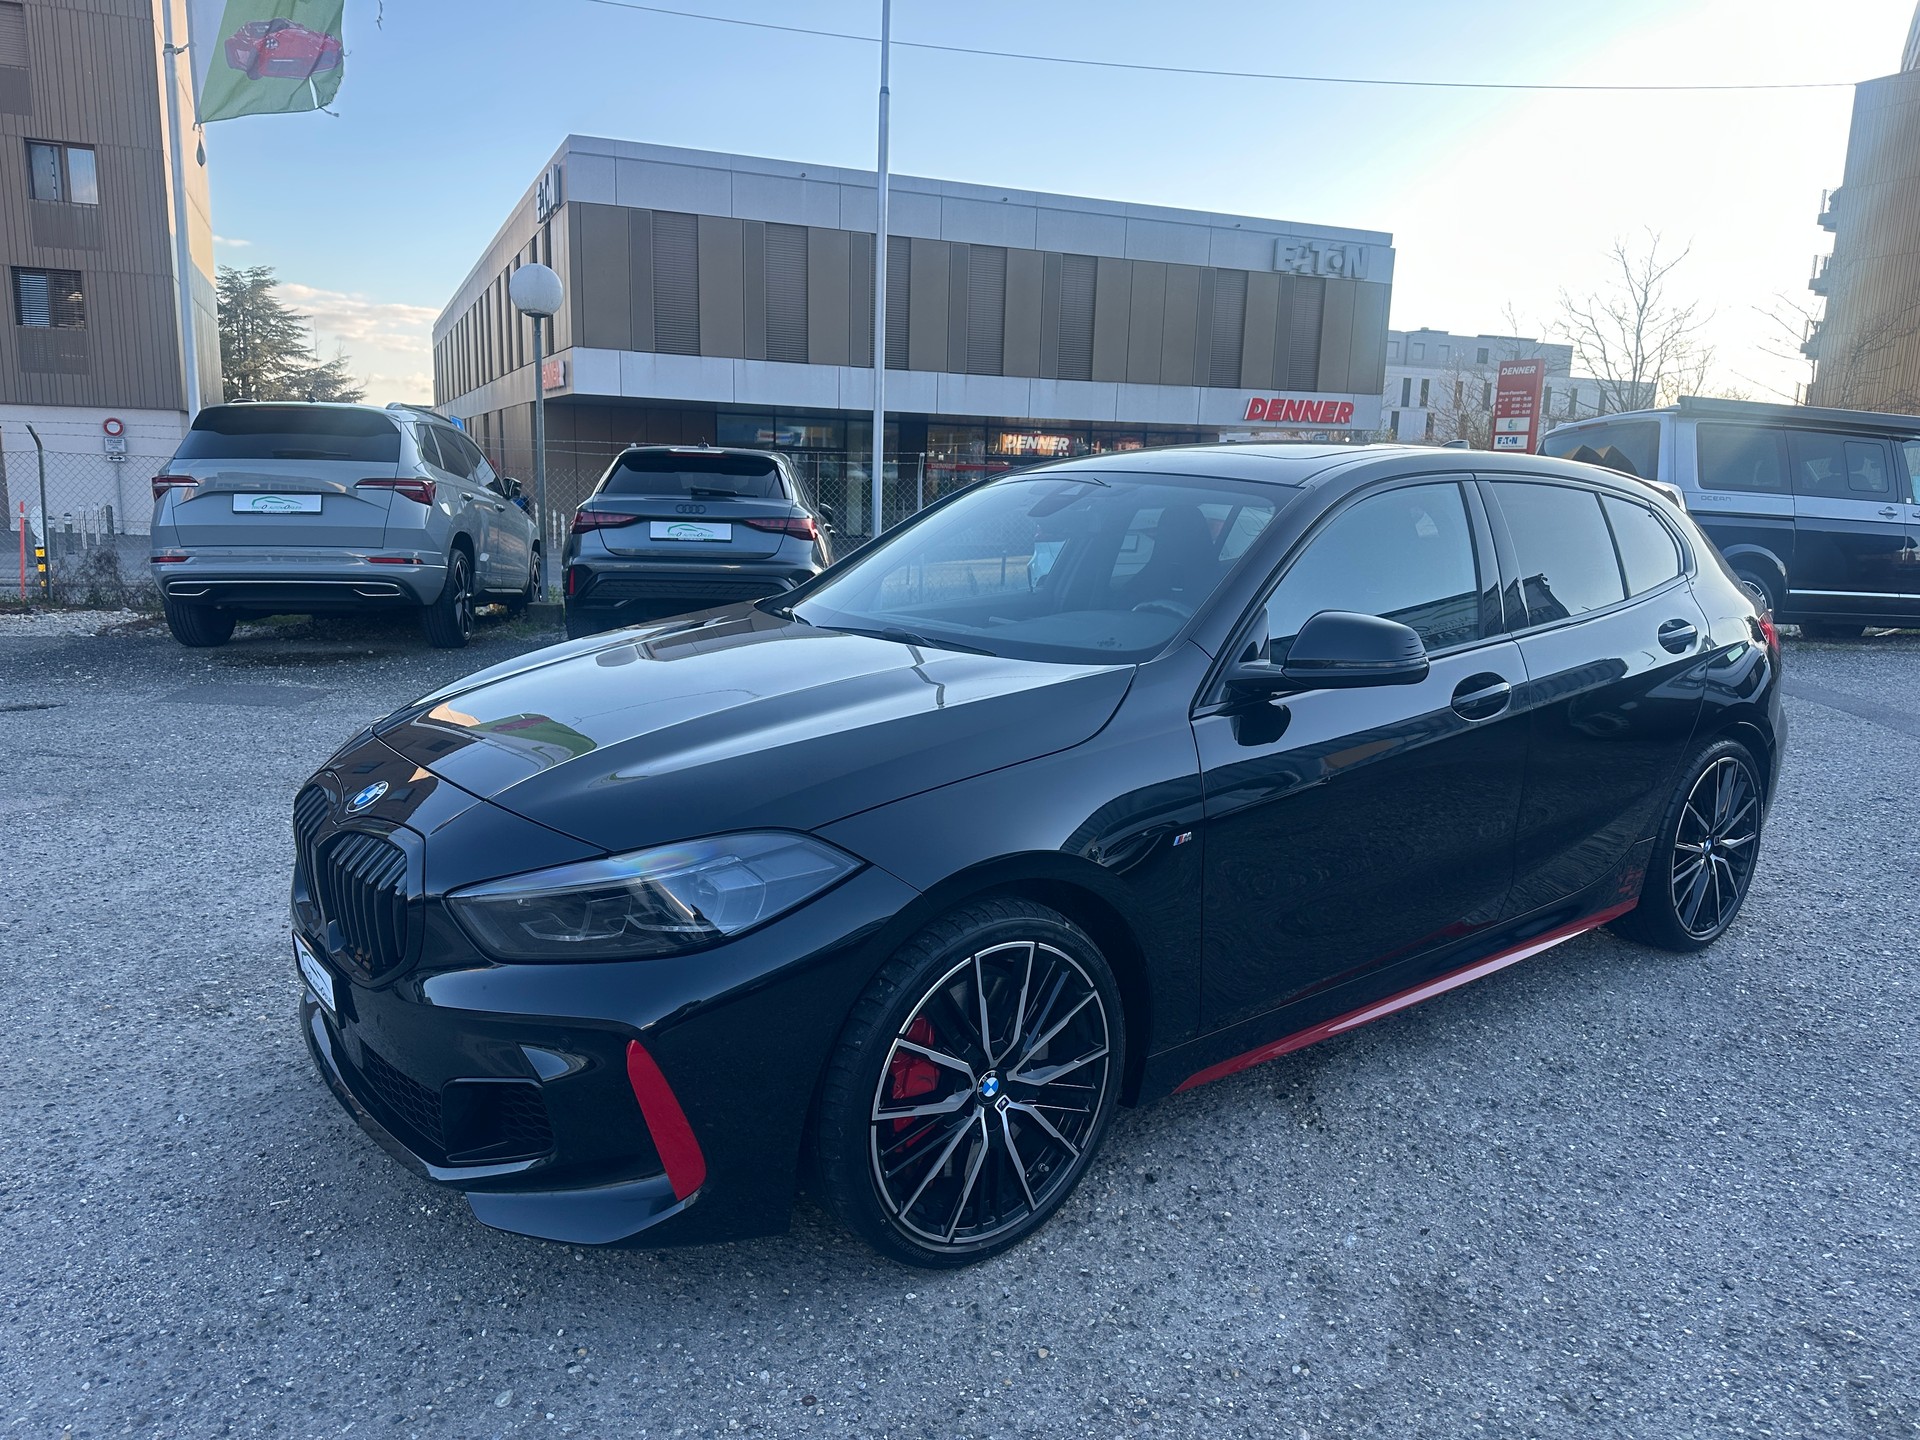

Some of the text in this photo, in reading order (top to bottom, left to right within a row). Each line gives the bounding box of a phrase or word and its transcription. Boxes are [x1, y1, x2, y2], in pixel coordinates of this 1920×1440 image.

[1273, 237, 1369, 279] EATON
[1501, 365, 1537, 375] DENNER
[1243, 397, 1355, 425] DENNER
[1005, 435, 1070, 451] DENNER
